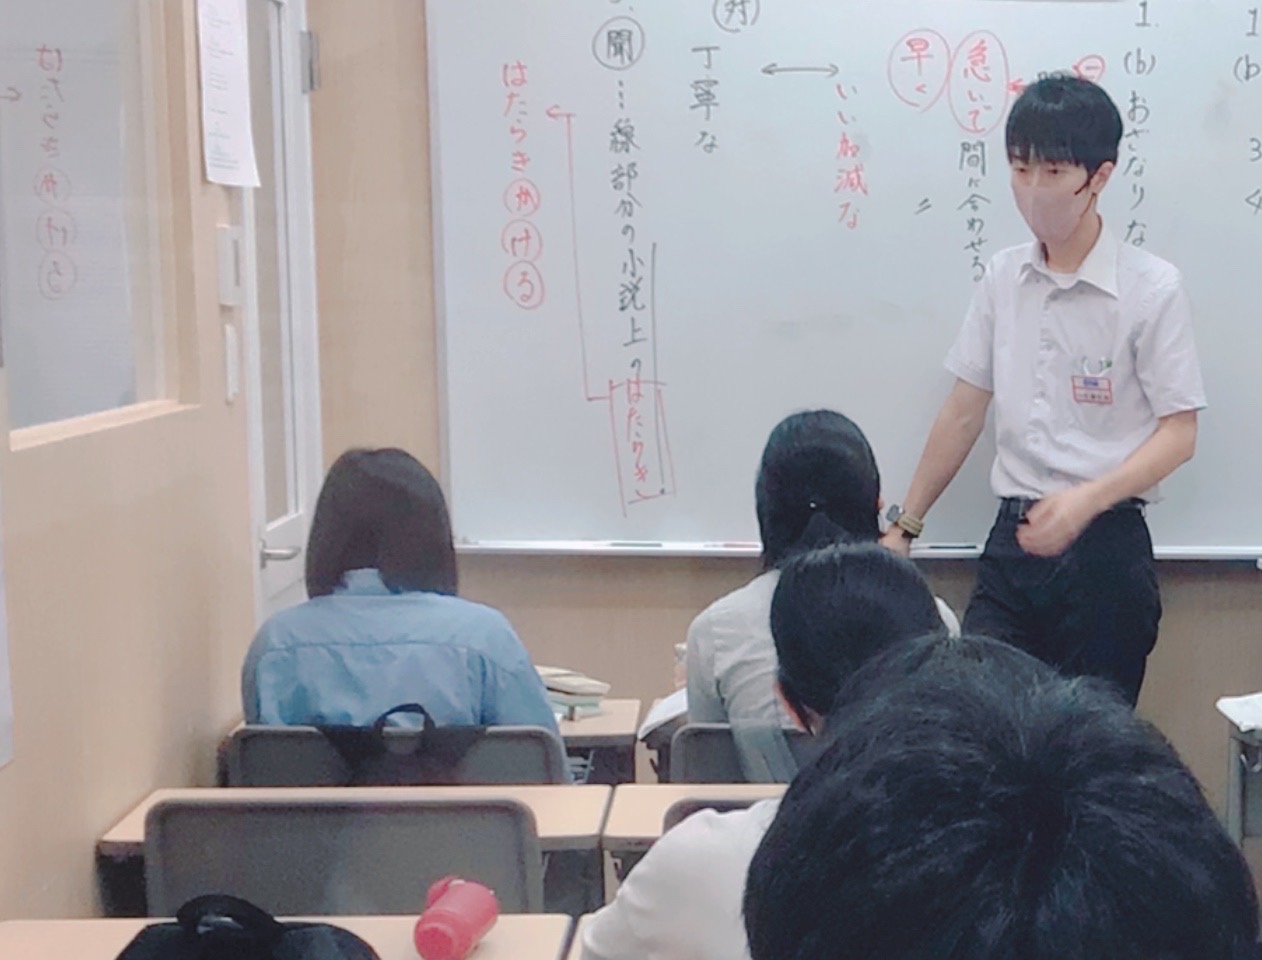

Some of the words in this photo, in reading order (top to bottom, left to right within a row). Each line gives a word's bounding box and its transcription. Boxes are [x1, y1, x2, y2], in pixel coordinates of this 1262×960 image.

[689, 46, 721, 154] 丁寧な
[900, 37, 935, 94] 早く
[834, 83, 869, 230] いい加減な
